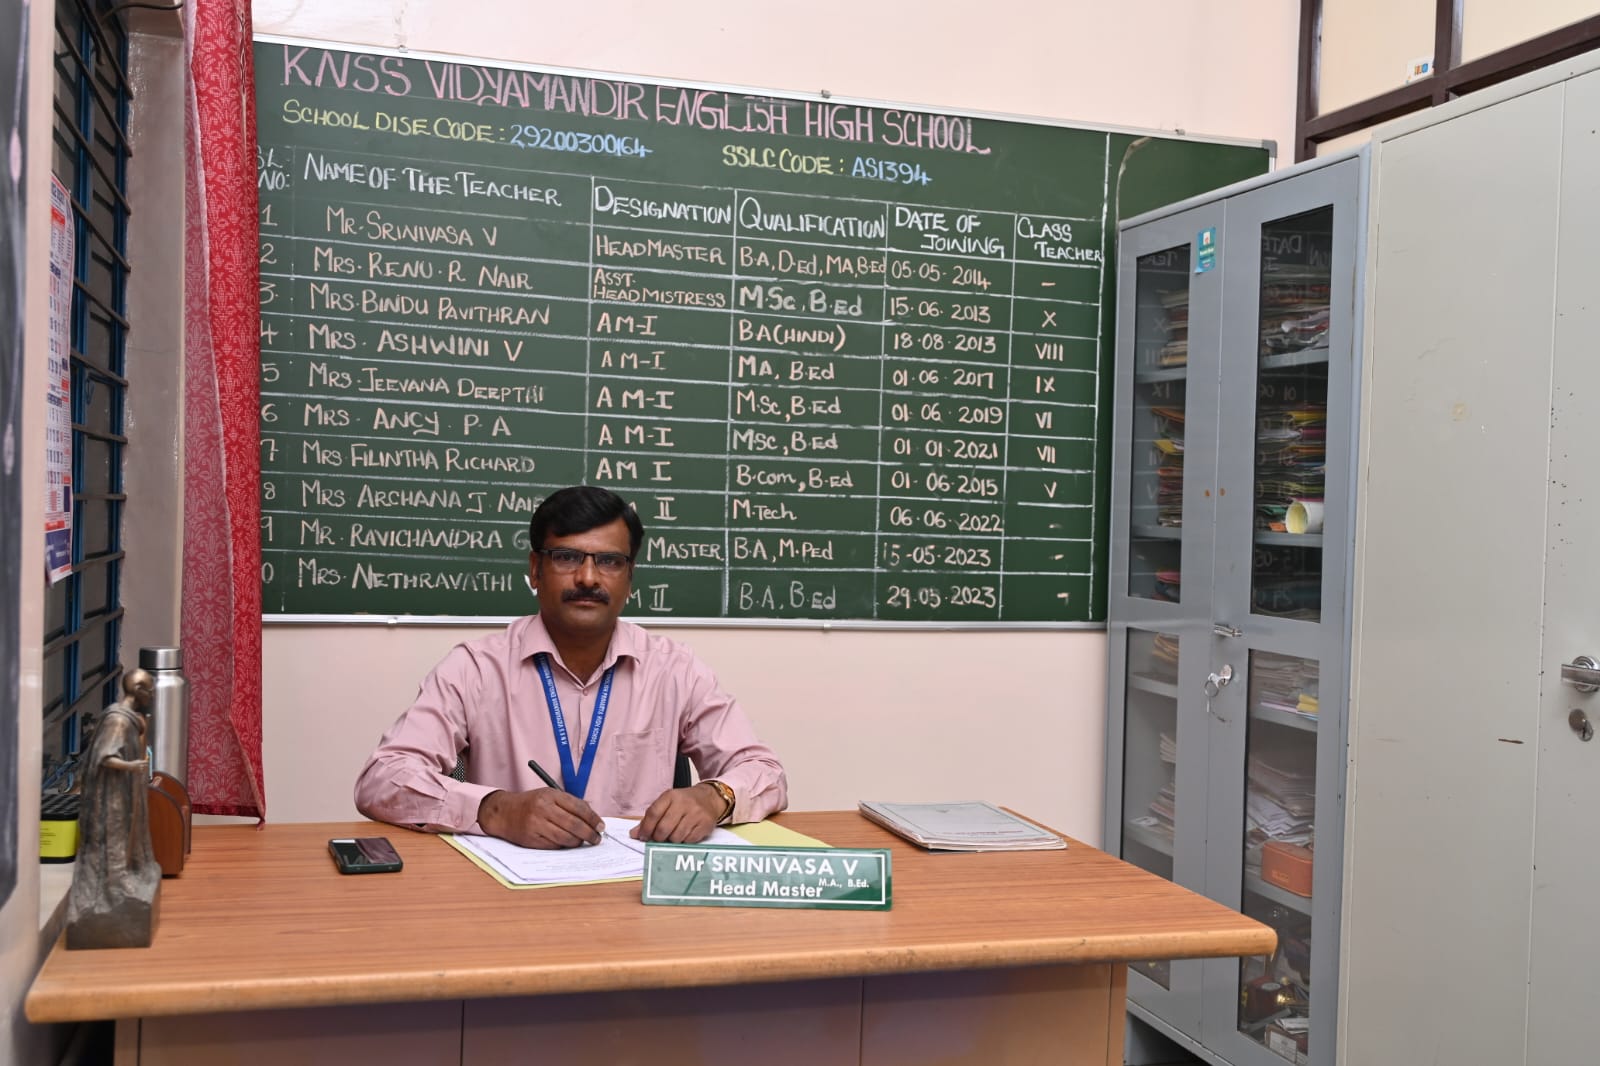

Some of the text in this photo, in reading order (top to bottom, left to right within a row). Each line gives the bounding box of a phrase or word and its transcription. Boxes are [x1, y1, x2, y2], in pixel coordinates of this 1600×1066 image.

[283, 45, 990, 154] KNSS VIDYAMANDIR ENGLISH HIGH SCHOOL
[283, 99, 369, 130] SCHOOL
[376, 113, 431, 136] DISE
[510, 124, 652, 158] 29200300164
[723, 144, 776, 169] SSLC
[304, 152, 562, 206] NAME OF THE TEACHER
[260, 204, 278, 227] 1
[594, 185, 731, 225] DESIGNATION
[367, 210, 473, 247] SRINIVASA
[482, 226, 498, 247] V
[739, 197, 885, 239] QUALIFICATION
[895, 206, 981, 234] DATE OF
[1017, 216, 1072, 242] CLASS
[259, 243, 278, 265] 2
[921, 234, 1004, 259] JOINING
[1034, 241, 1103, 262] TEACHER
[478, 265, 533, 290] NAIR
[361, 289, 429, 315] BINDU
[438, 297, 551, 326] PAVITHRAN
[1042, 310, 1057, 328] X
[260, 320, 279, 346] 4
[377, 329, 490, 358] ASHWINI
[504, 340, 524, 363] V
[1035, 342, 1064, 362] VIII
[261, 362, 281, 383] 5
[361, 367, 450, 394] JEEVANA
[261, 402, 279, 423] 6
[1035, 411, 1052, 430] VI
[492, 416, 512, 437] A
[260, 438, 279, 462] 7
[445, 448, 536, 474] RICHARD
[1036, 445, 1056, 464] VII
[263, 482, 277, 500] 8
[356, 483, 462, 509] ARCHANA
[1043, 481, 1057, 499] V
[260, 516, 274, 542] 9
[351, 523, 503, 549] RAVICHANDRA
[647, 536, 726, 562] MASTER
[351, 562, 513, 592] NETHRAVATHI
[675, 855, 858, 876] Mr SRINIVASA V
[710, 879, 823, 898] Head Master
